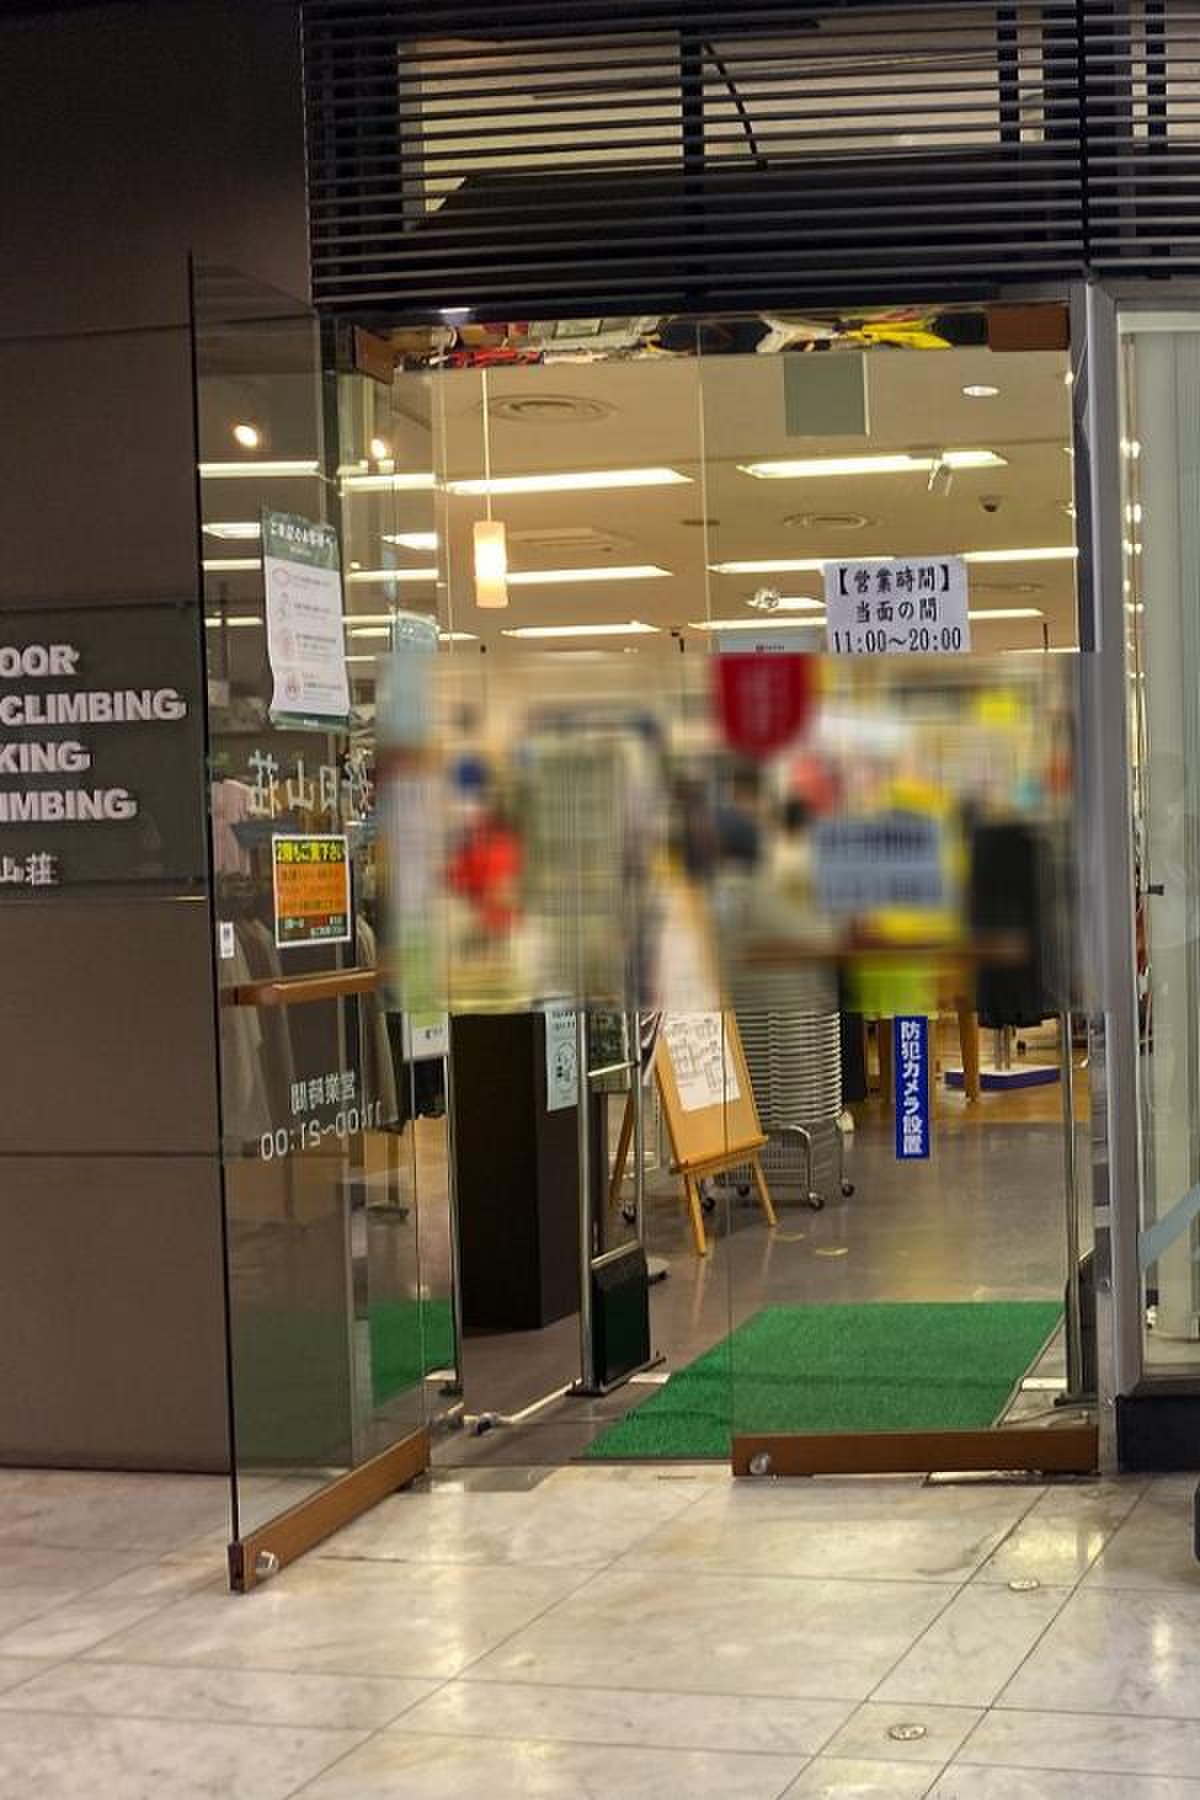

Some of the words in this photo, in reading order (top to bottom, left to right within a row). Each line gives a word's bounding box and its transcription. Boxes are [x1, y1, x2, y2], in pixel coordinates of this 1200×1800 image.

[855, 597, 938, 624] 当面の間
[0, 688, 187, 727] CLIMBING
[901, 1020, 924, 1156] 防犯カメラ設置
